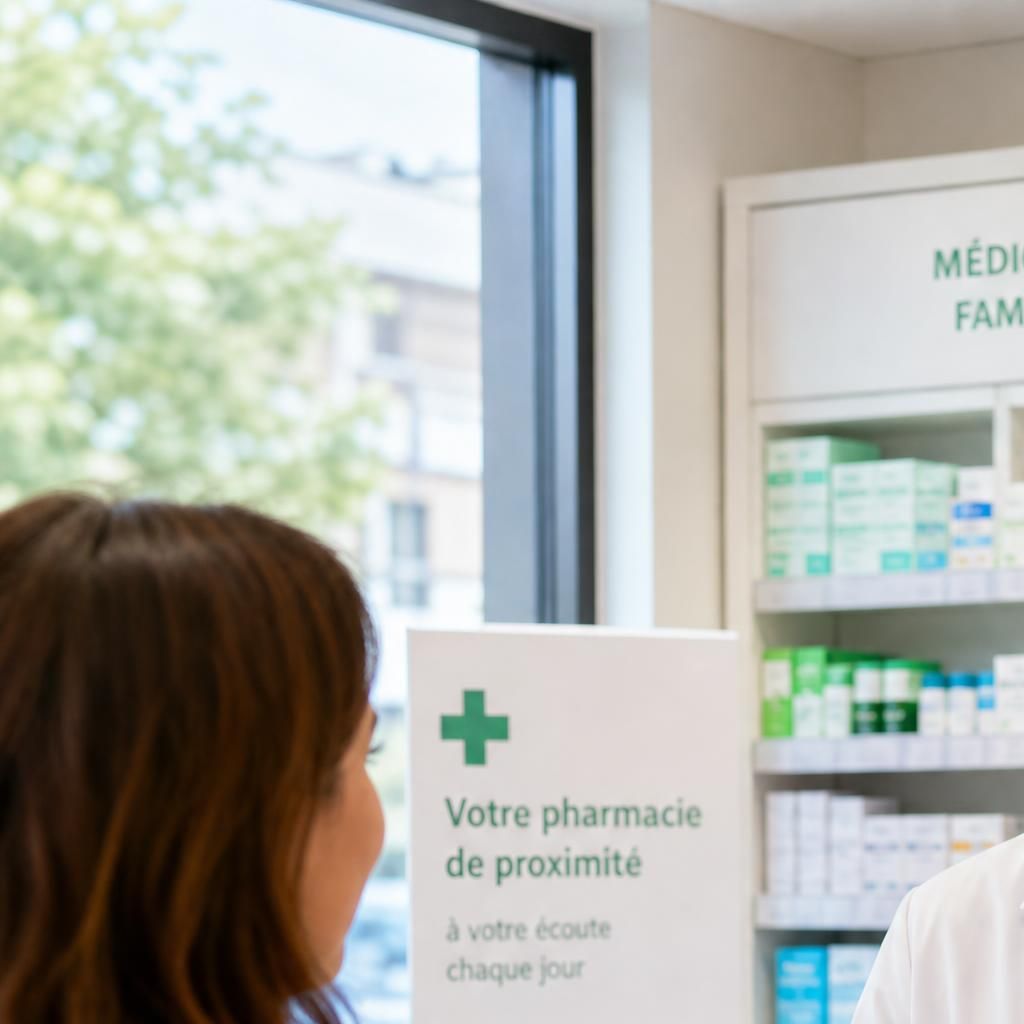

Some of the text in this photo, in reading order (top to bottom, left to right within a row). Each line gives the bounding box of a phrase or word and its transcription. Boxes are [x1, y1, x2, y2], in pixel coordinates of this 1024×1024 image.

[444, 797, 702, 835] Votre pharmacie
[445, 846, 642, 887] de proximité
[446, 916, 611, 942] à votre écoute
[446, 955, 584, 986] chaque jour
